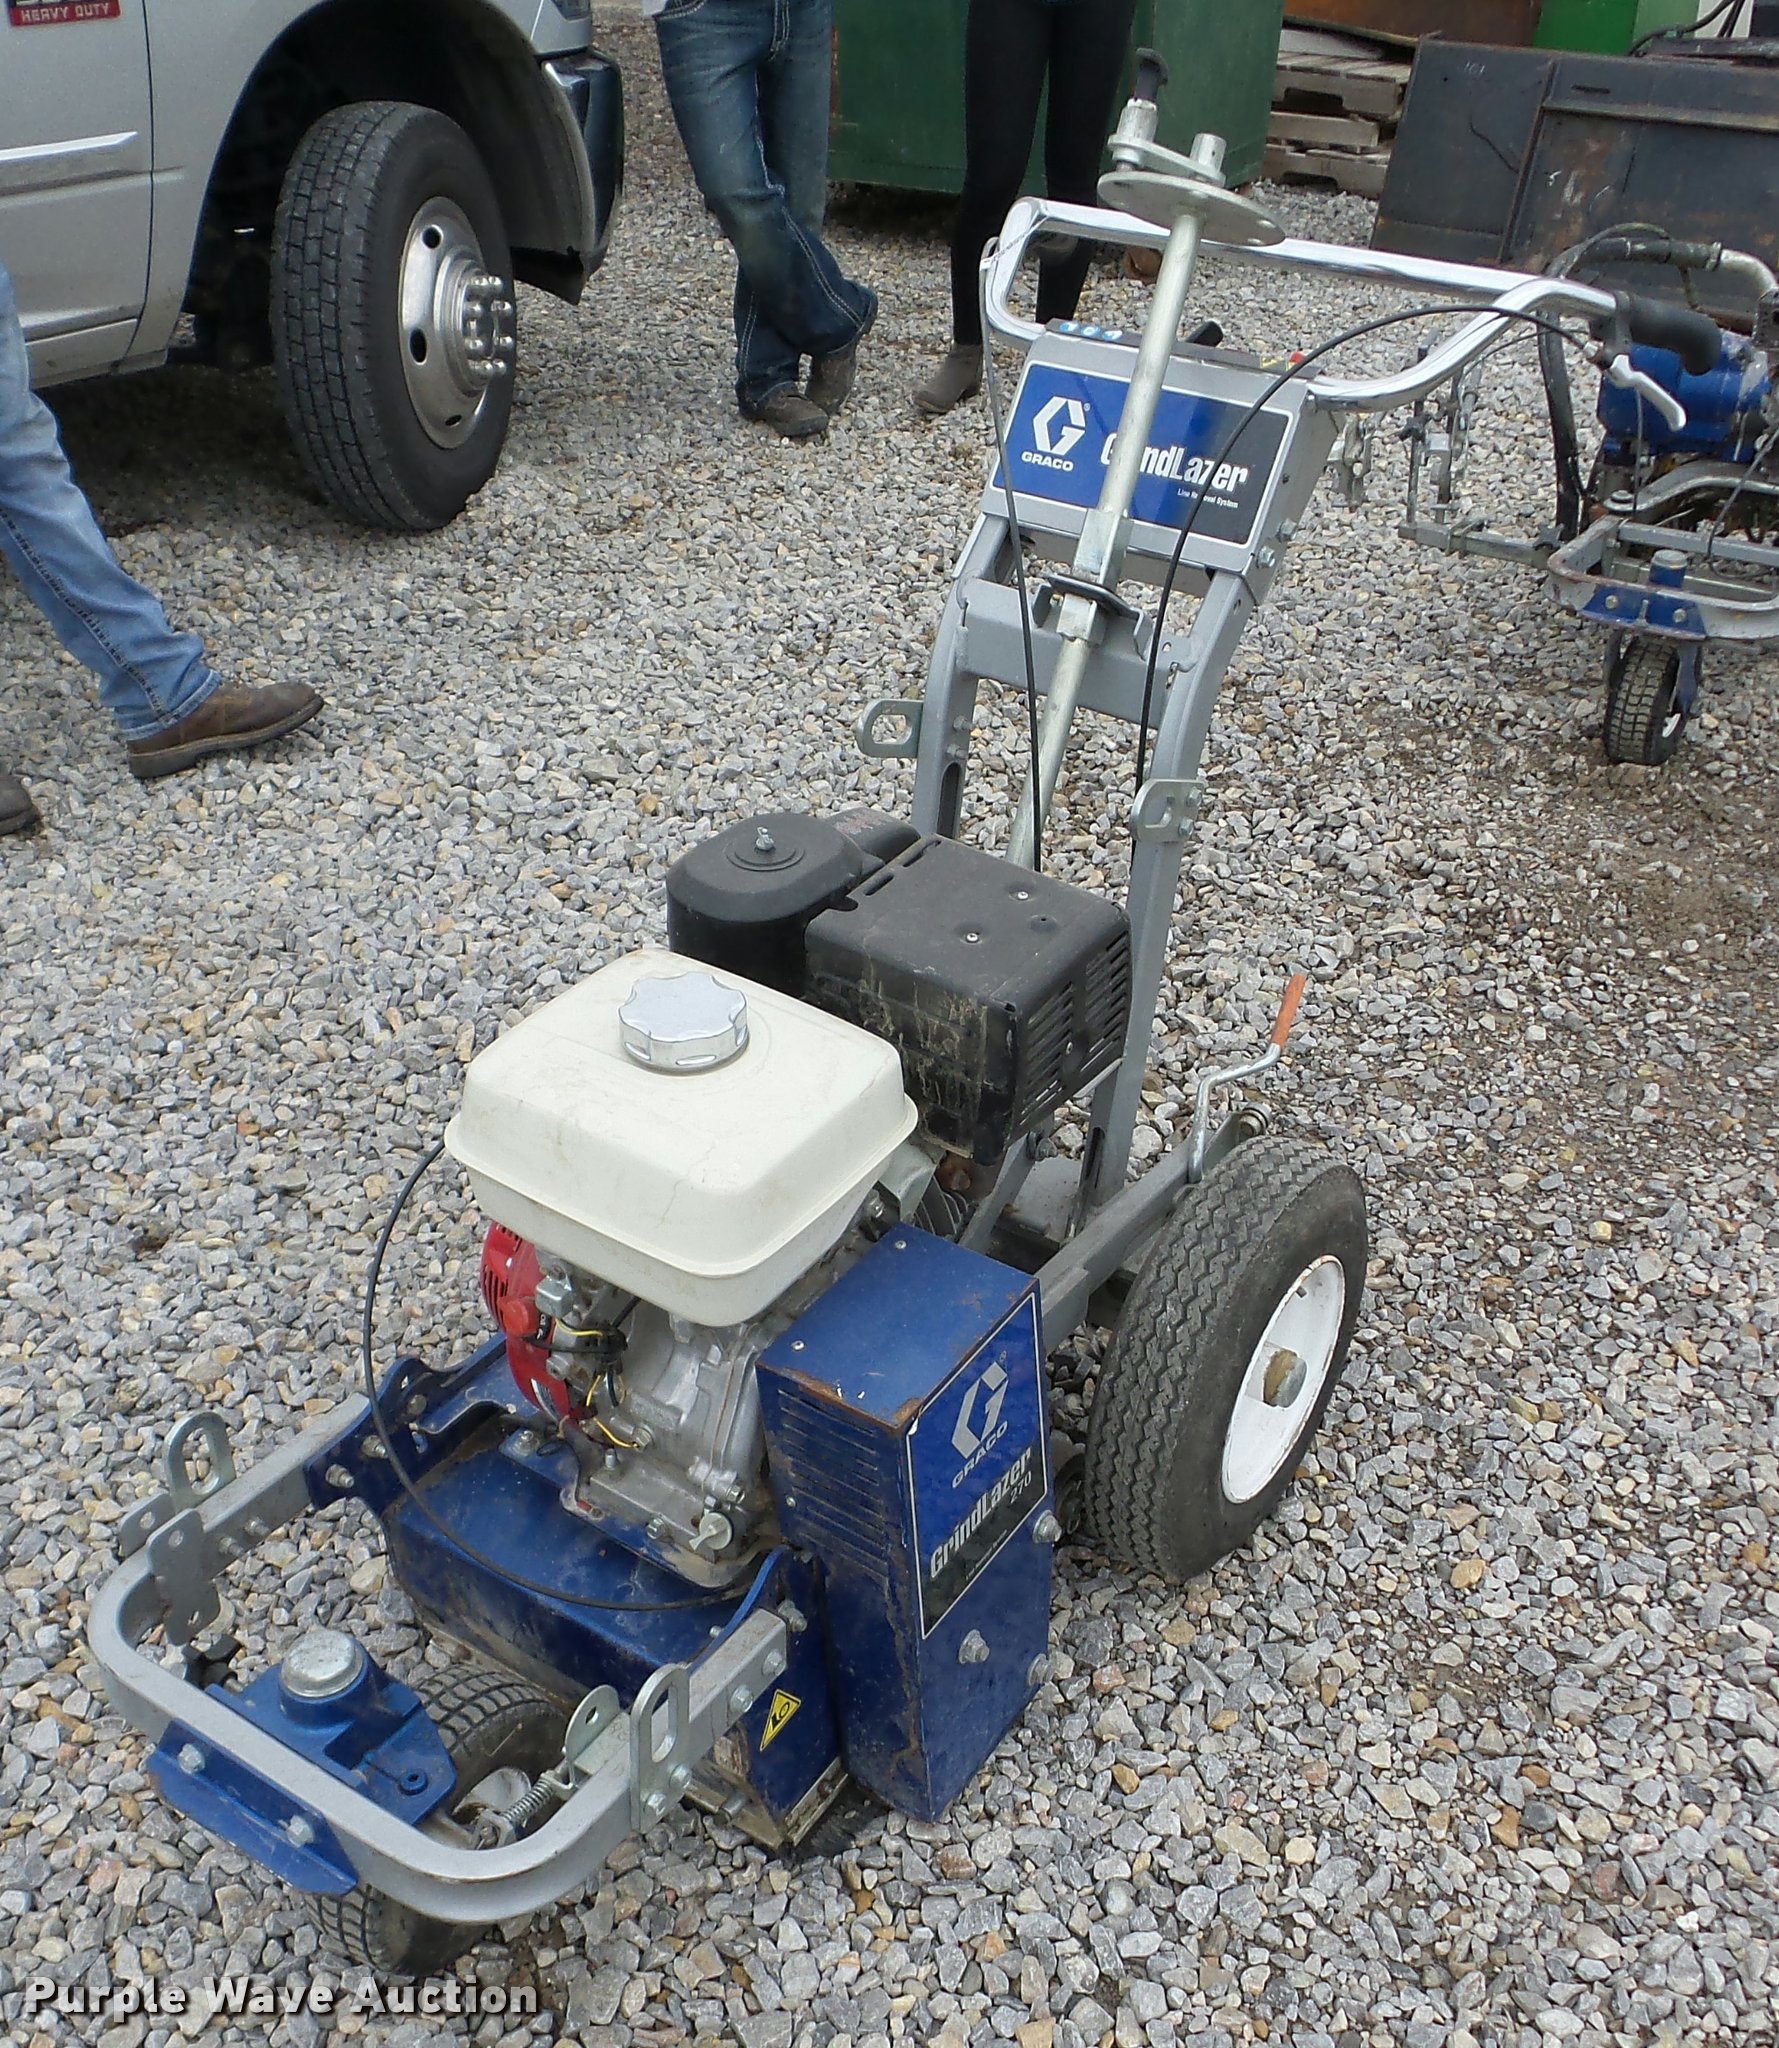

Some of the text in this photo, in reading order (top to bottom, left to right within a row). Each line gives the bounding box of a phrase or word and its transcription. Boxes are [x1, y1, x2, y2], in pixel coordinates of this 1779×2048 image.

[20, 2, 110, 22] HEAVY DUTY
[1021, 451, 1074, 472] GRACO
[1100, 432, 1249, 492] GndLazer
[952, 1420, 1008, 1488] GRACO
[1010, 1470, 1032, 1504] 270
[930, 1447, 1032, 1579] GrindLazer
